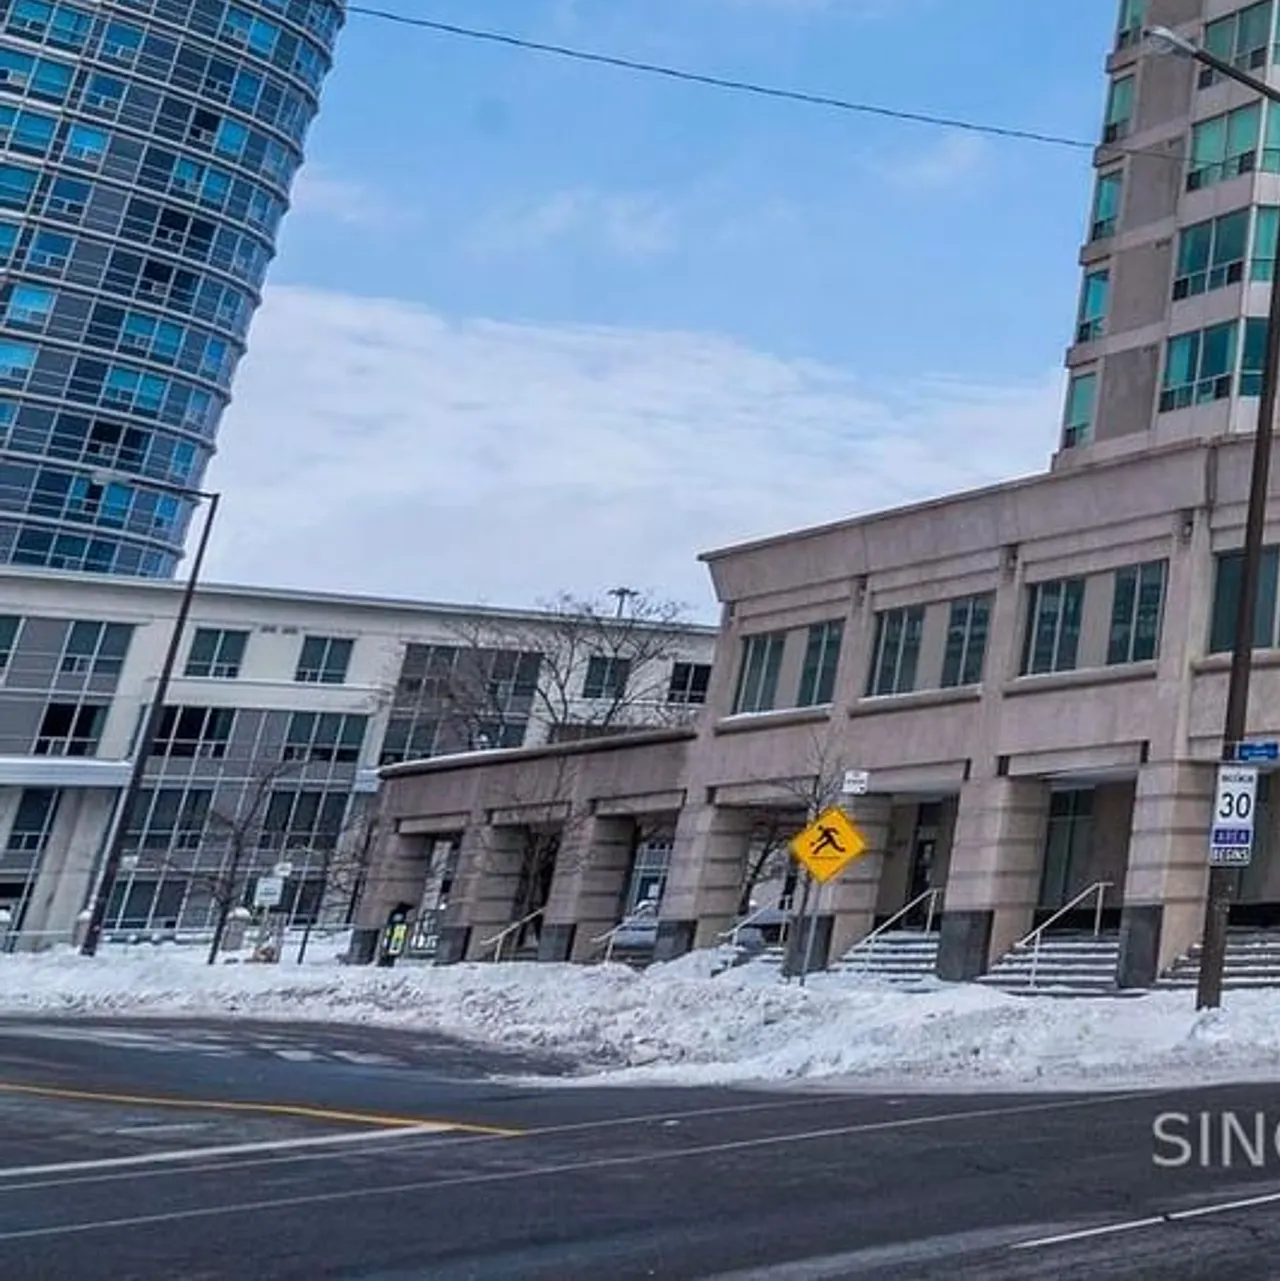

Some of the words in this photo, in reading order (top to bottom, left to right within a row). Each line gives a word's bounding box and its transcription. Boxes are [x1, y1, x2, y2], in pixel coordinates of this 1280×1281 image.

[1219, 792, 1251, 819] 30
[1215, 830, 1249, 844] AREA
[1212, 847, 1249, 861] BEGINS
